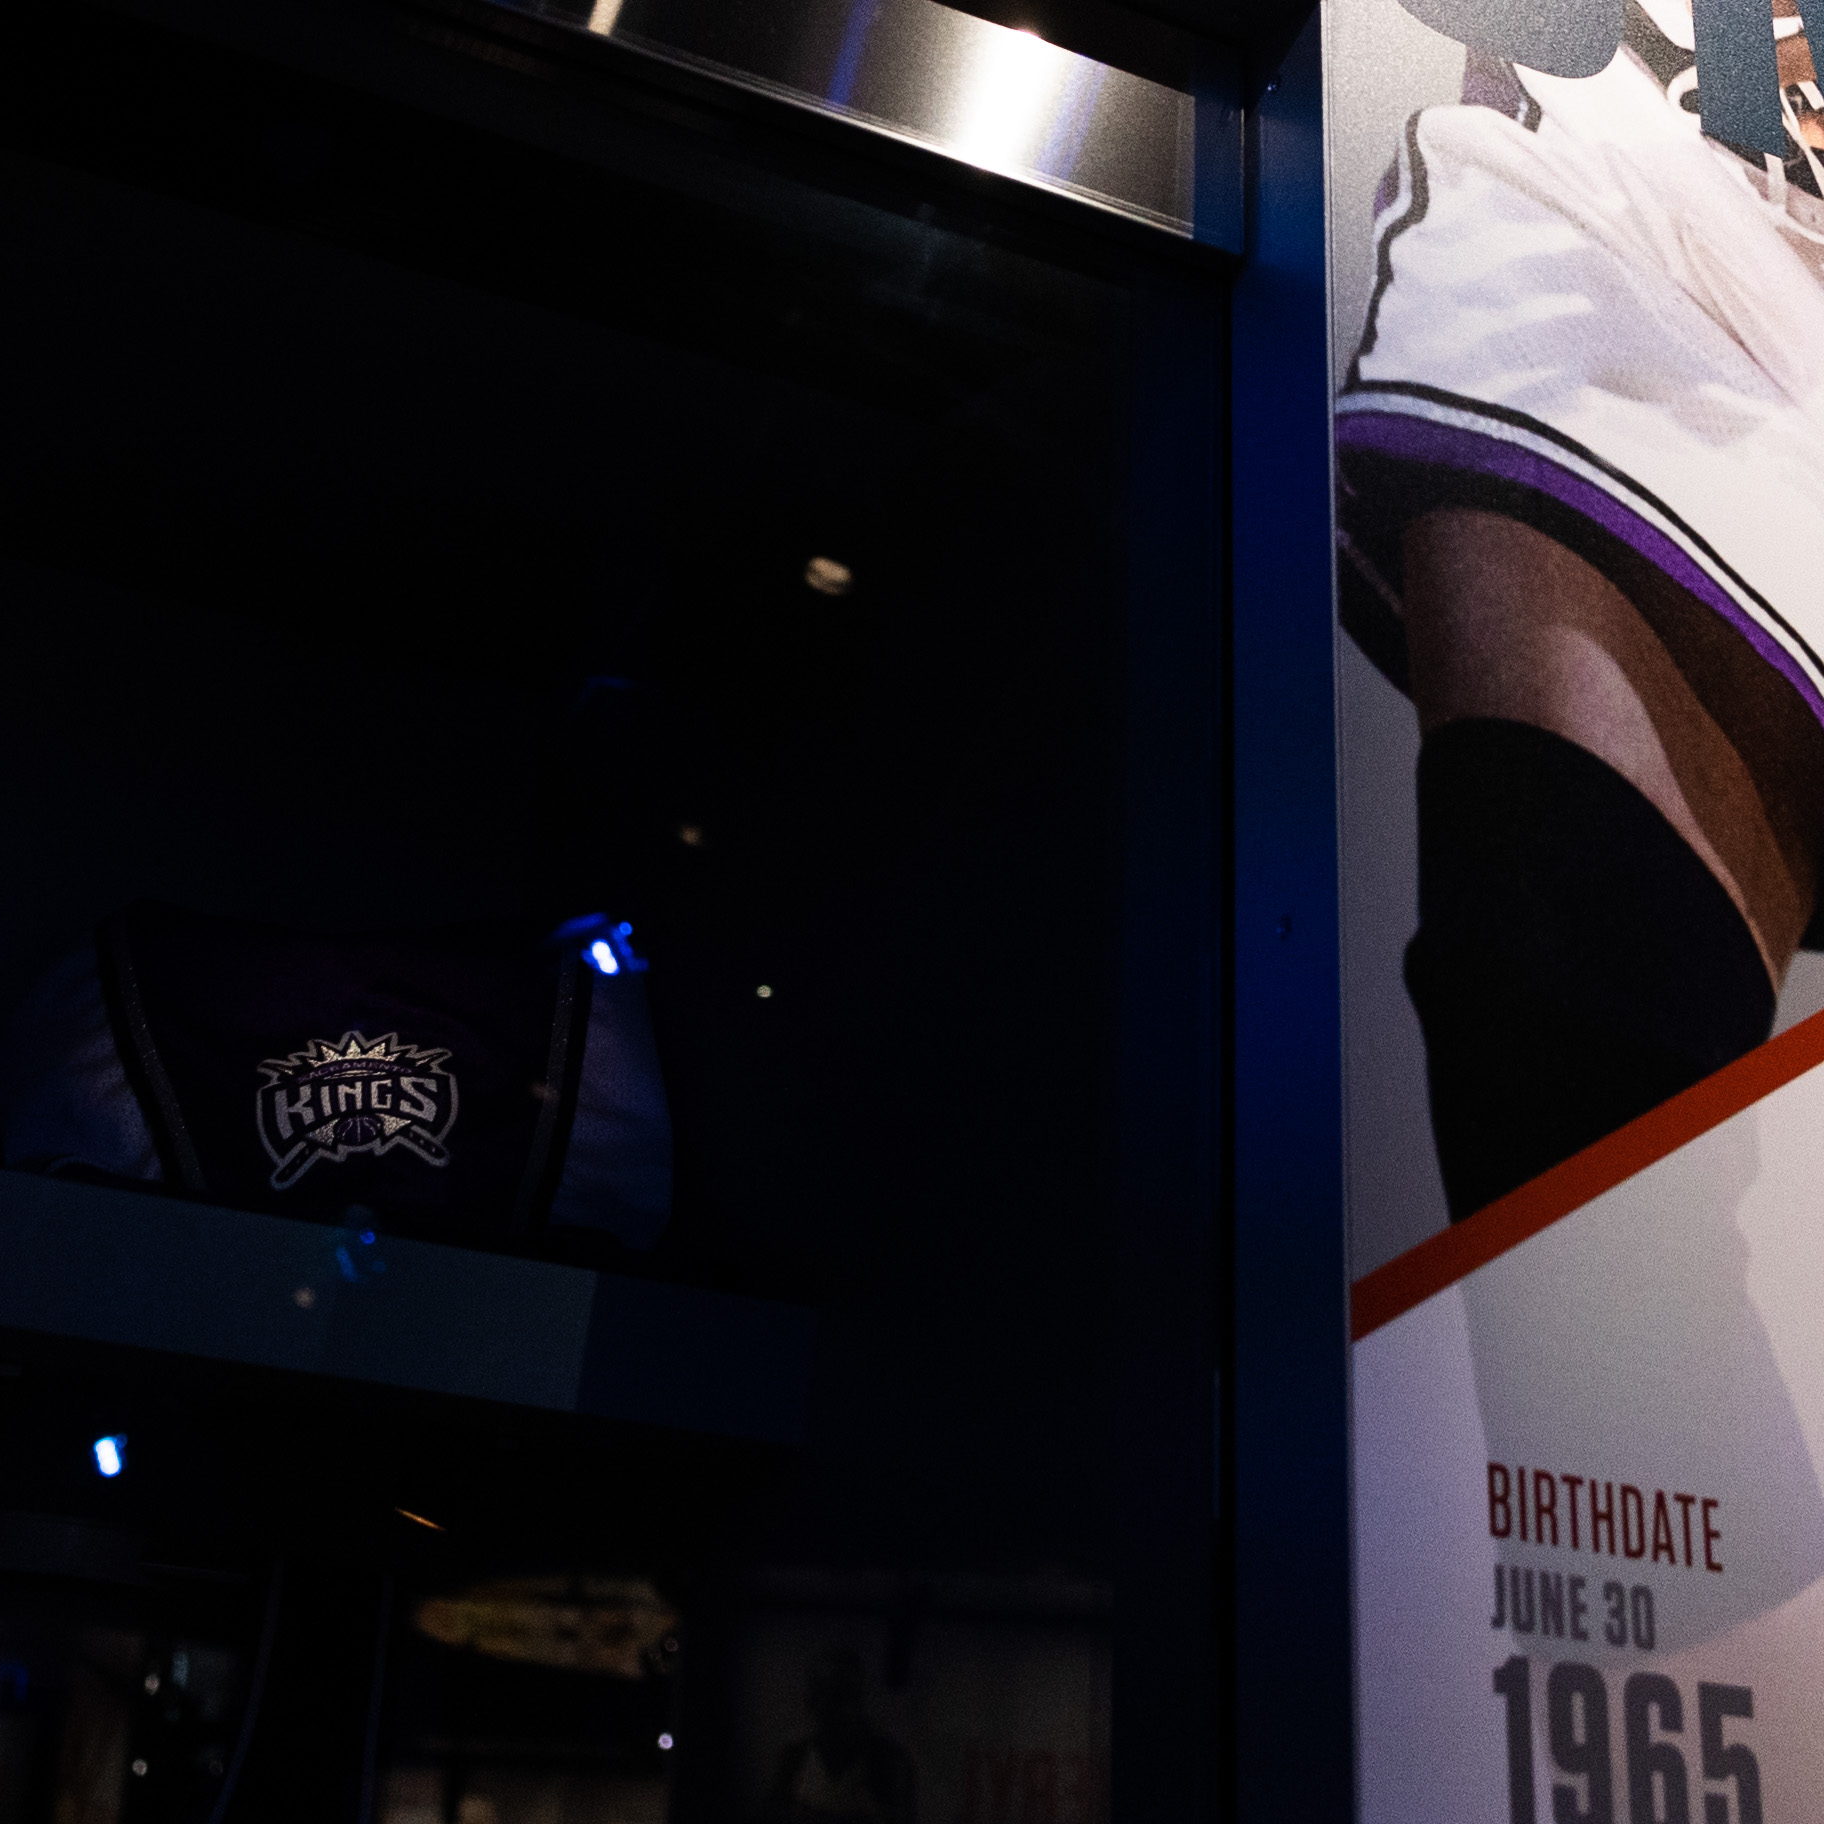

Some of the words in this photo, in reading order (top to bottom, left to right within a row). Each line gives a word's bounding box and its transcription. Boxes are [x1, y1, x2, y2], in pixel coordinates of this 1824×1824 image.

[273, 1075, 439, 1141] KINGS
[1487, 1461, 1724, 1573] BIRTHDATE
[1490, 1563, 1590, 1643] JUNE
[1602, 1580, 1657, 1651] 30
[1492, 1654, 1764, 1824] 1965
